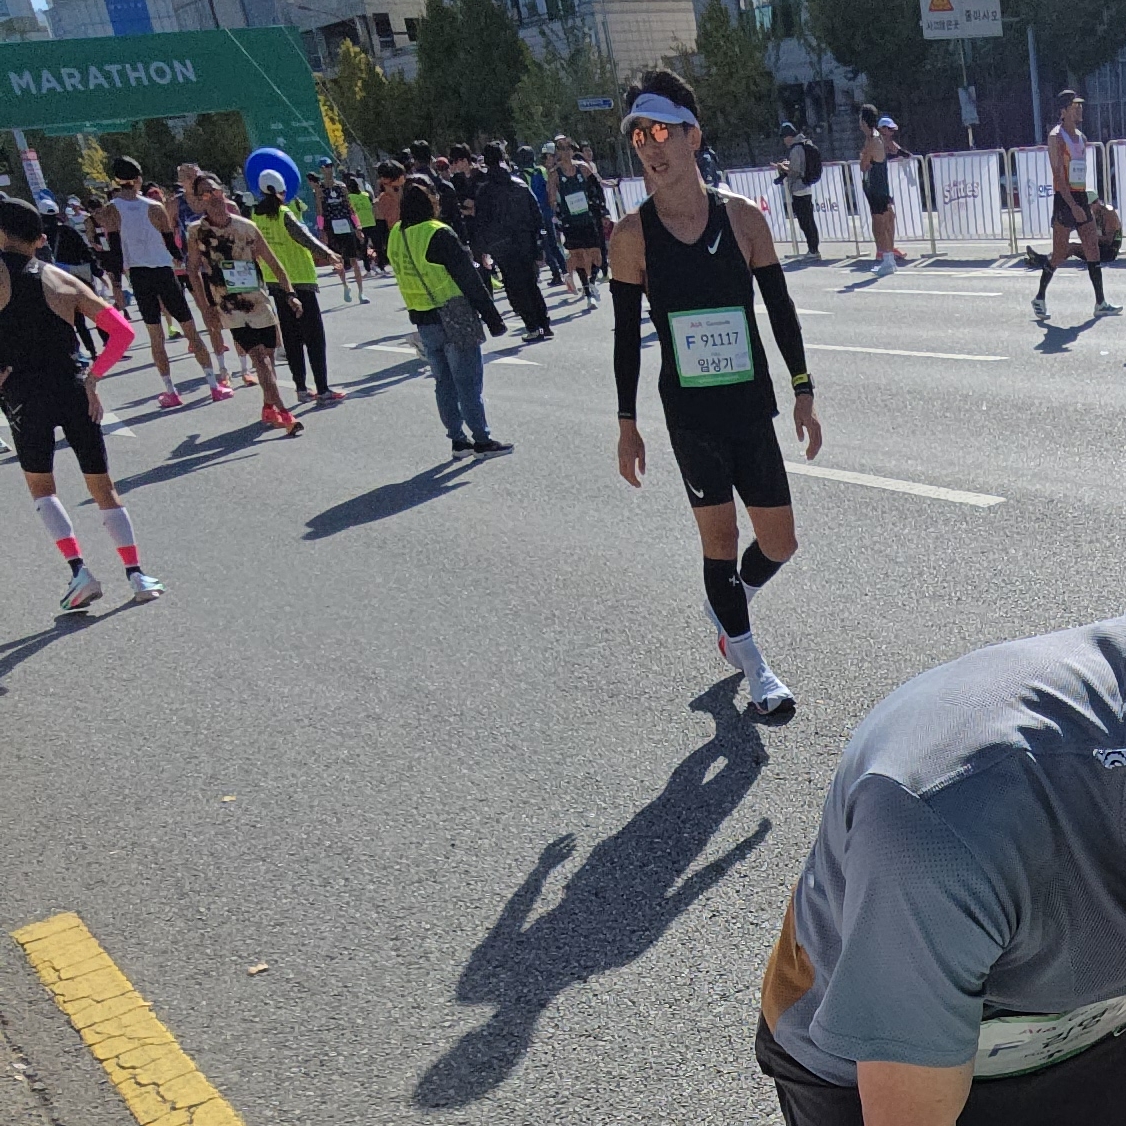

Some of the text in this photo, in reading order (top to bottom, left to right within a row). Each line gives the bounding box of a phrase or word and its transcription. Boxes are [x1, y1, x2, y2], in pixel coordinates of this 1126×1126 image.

[8, 59, 197, 96] MARATHON
[685, 331, 739, 350] F 91117
[697, 356, 733, 373] 임상기
